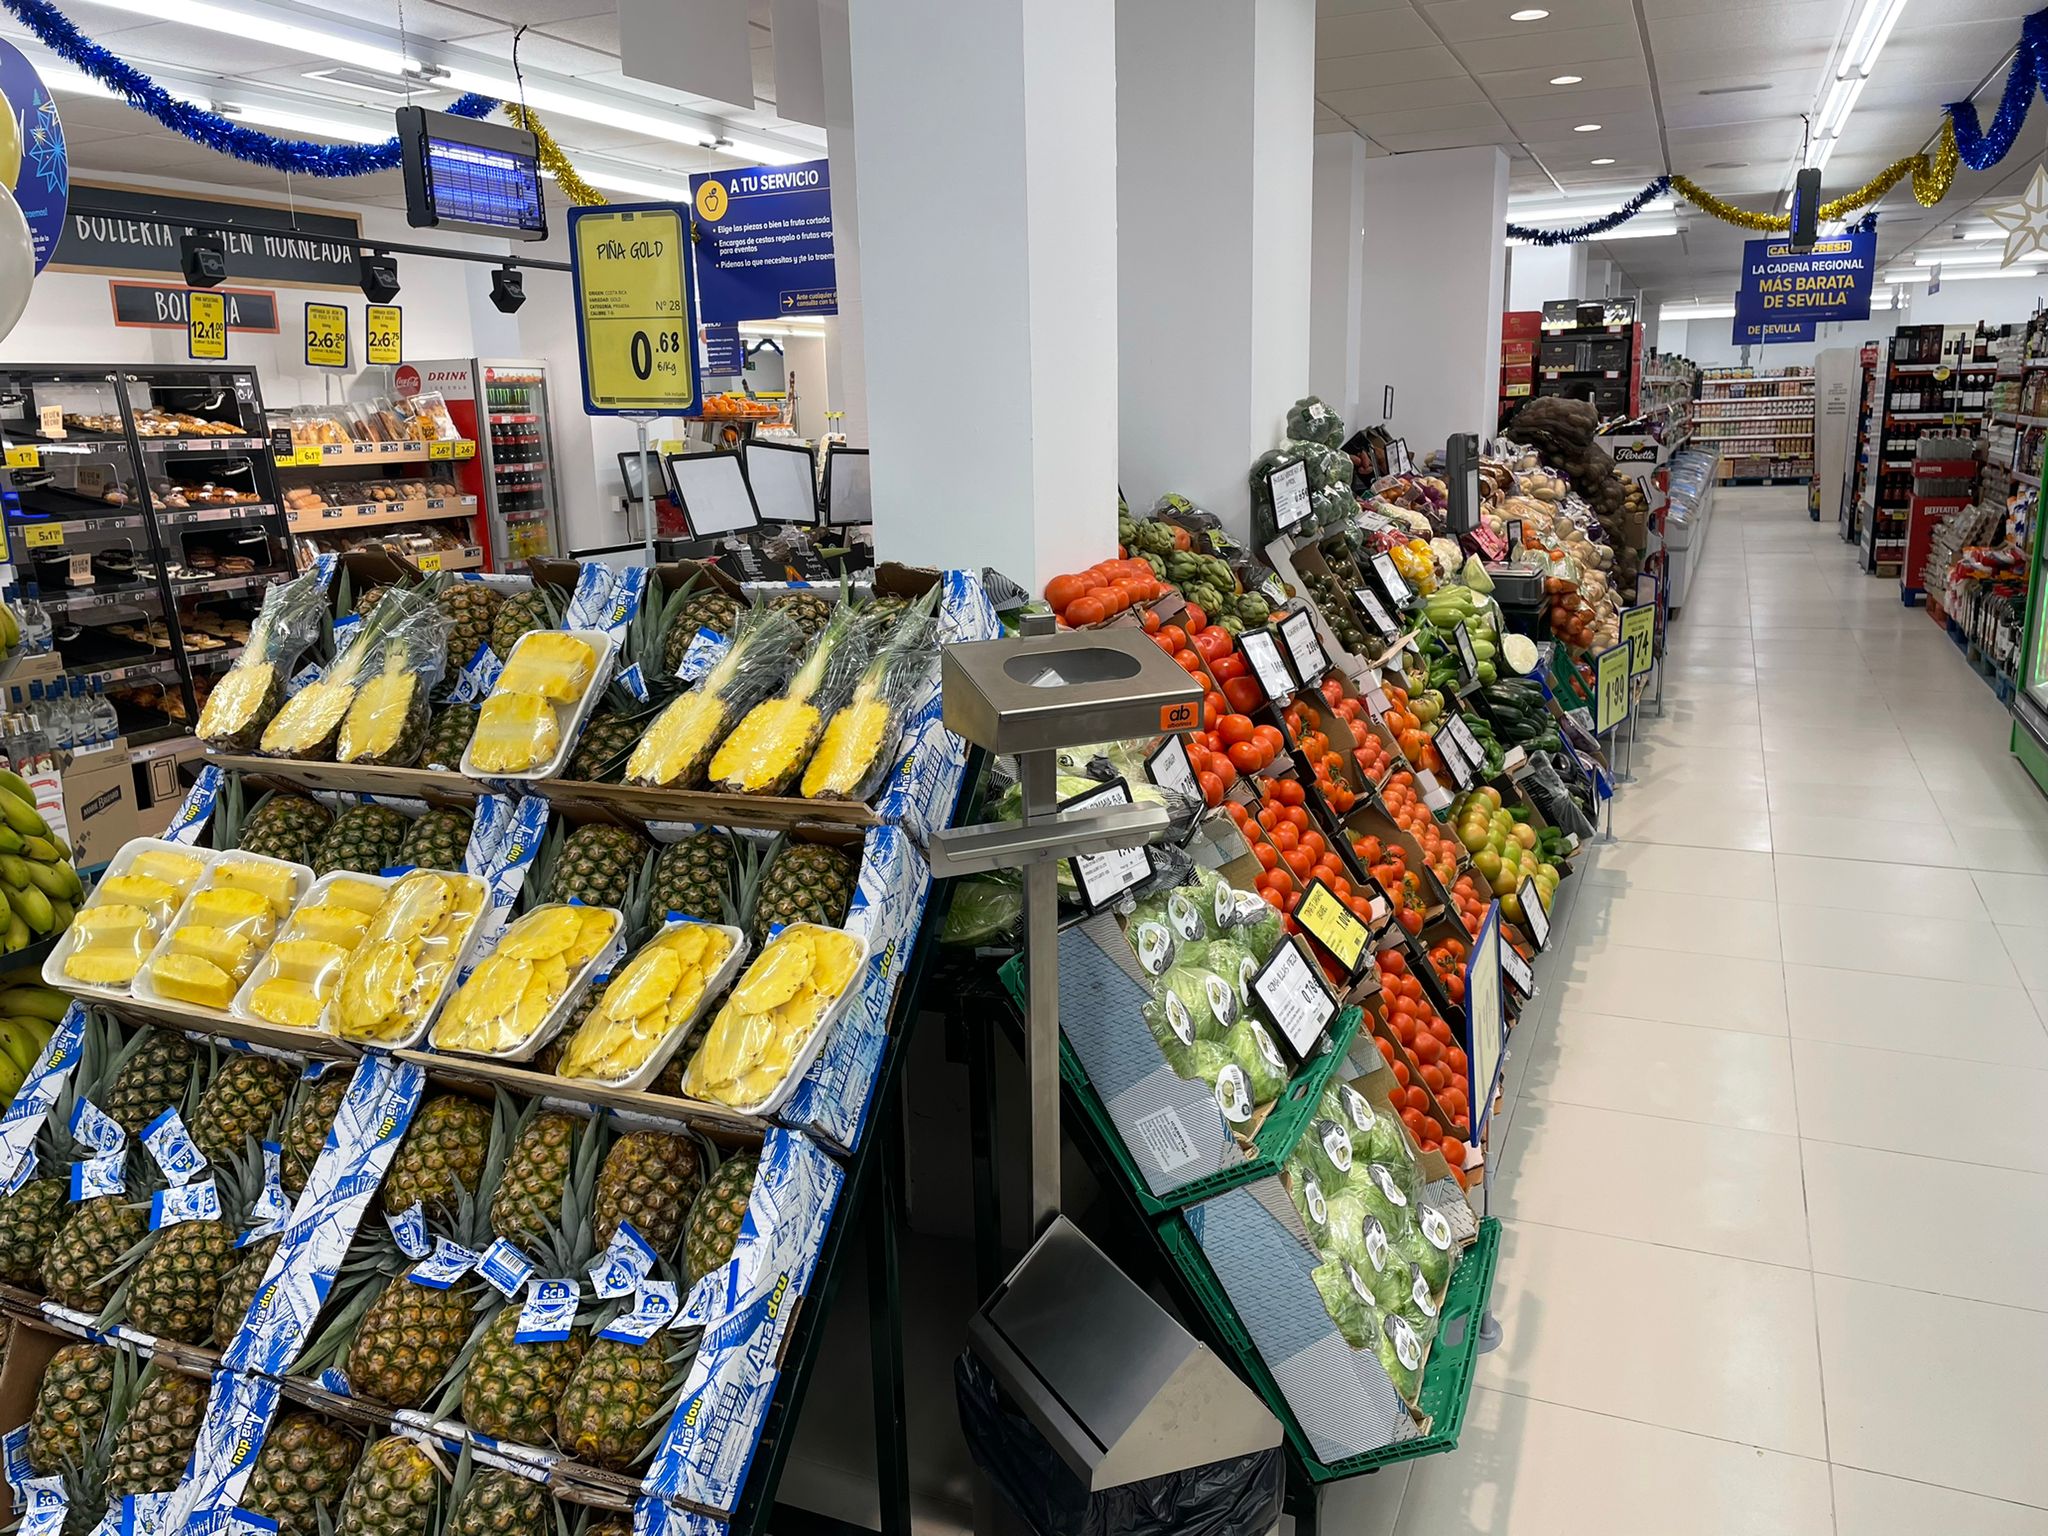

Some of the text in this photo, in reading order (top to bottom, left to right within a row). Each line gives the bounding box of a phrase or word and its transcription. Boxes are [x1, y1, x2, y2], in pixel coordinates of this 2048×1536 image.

[730, 169, 819, 194] A TU SERVICIO
[717, 225, 733, 235] Elige
[743, 222, 763, 232] piezas
[768, 220, 782, 229] bien
[782, 219, 790, 227] la
[790, 217, 806, 227] fruta
[805, 215, 831, 225] cortada
[719, 238, 747, 248] Encargos
[746, 237, 755, 245] de
[755, 235, 775, 244] cestas
[775, 233, 796, 243] regalo
[801, 231, 820, 240] frutas
[596, 240, 664, 260] PIÑA GOLD
[719, 245, 758, 257] para eventos
[751, 258, 764, 267] que
[764, 255, 793, 265] necesitas
[1752, 258, 1864, 275] LA CADENA REGIONAL
[1759, 274, 1856, 293] MÁS BARATA
[669, 300, 681, 311] 28
[1763, 291, 1847, 309] DE SEVILLA
[1747, 323, 1801, 335] DE SEVILLA
[427, 371, 468, 381] DRINK
[1615, 447, 1656, 462] Florette
[1924, 505, 1960, 516] BEEFEATER
[611, 588, 636, 622] Ana'dou
[1169, 704, 1191, 721] ab
[893, 754, 916, 794] Ana'dou
[183, 784, 212, 822] Ana'dou
[506, 823, 534, 863] Ana'dou
[48, 1029, 79, 1069] Ana'dou
[377, 1092, 409, 1140] Ana'dou
[175, 1150, 193, 1168] SCB
[401, 1226, 411, 1247] SCB
[449, 1243, 472, 1258] SCB
[542, 1288, 565, 1299] SCB
[245, 1284, 277, 1336] Ana'dou
[645, 1303, 665, 1313] SCB
[747, 1270, 790, 1374] Ana'dou
[671, 1397, 703, 1457] Ana'dou
[230, 1411, 265, 1465] Ana'dou
[39, 1496, 59, 1507] SCB
